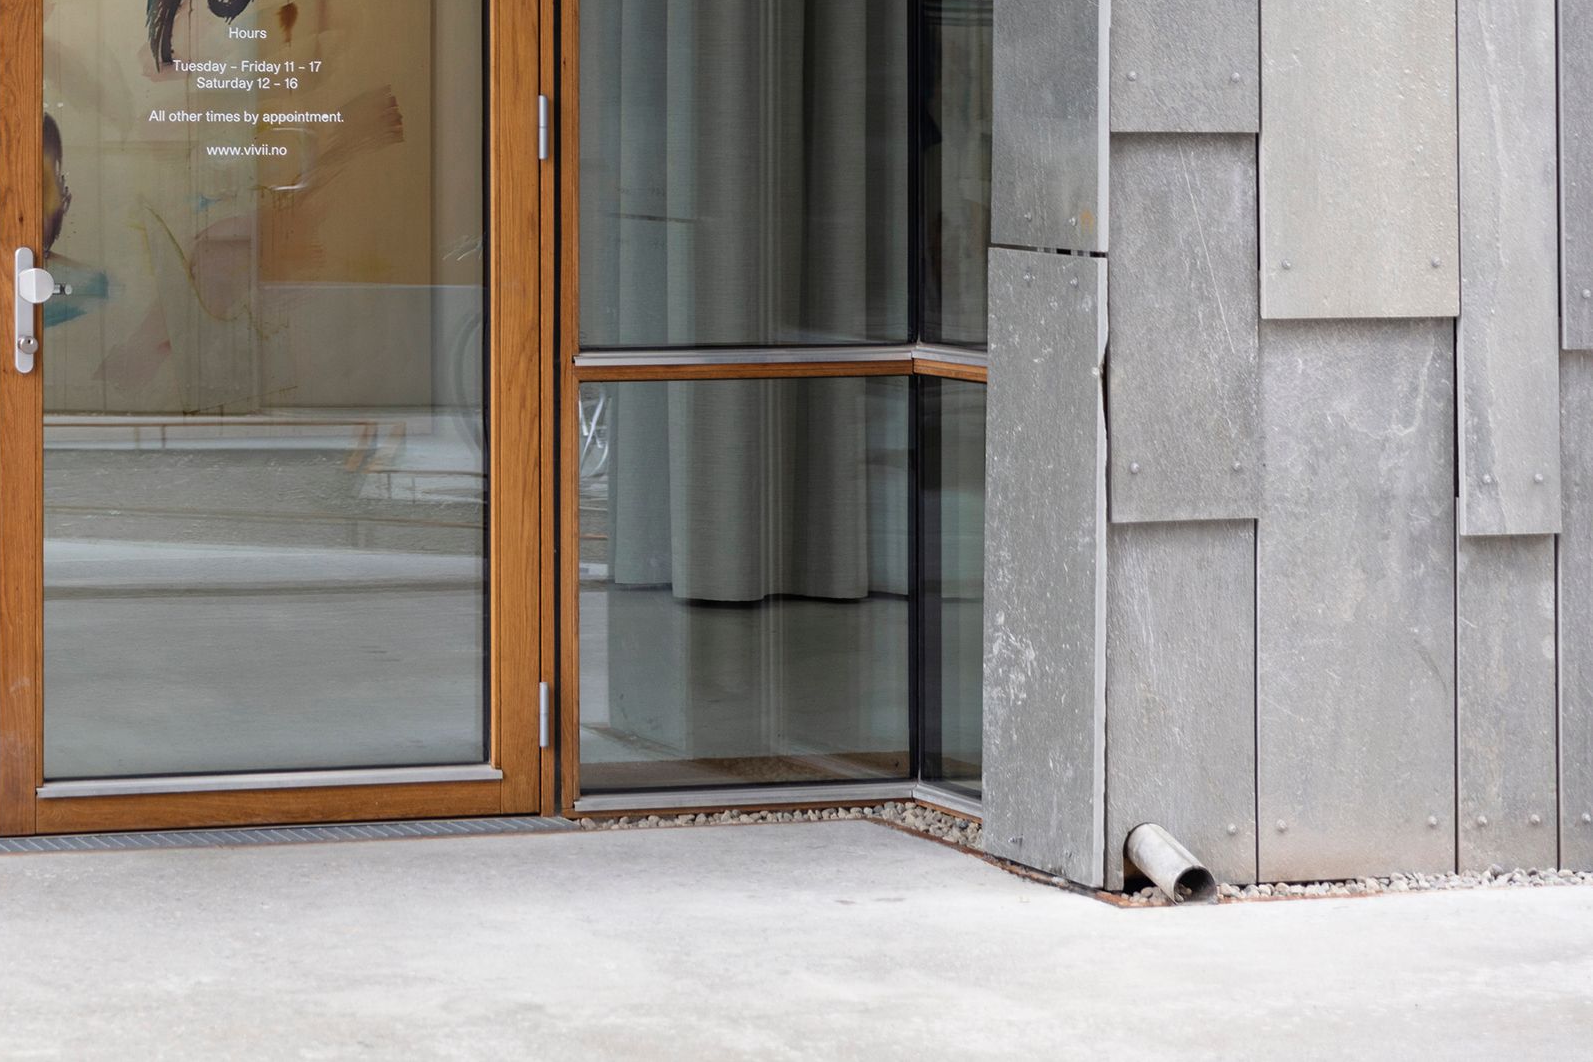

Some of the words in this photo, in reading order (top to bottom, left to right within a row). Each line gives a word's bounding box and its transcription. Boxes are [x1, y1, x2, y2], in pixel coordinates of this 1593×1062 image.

[228, 26, 267, 39] Hours
[172, 59, 228, 75] Tuesday
[240, 60, 281, 75] Friday
[284, 61, 294, 72] 11
[309, 61, 322, 72] 17
[196, 76, 254, 92] Saturday
[256, 77, 271, 89] 12
[284, 77, 298, 90] 16
[149, 109, 166, 123] All
[168, 109, 203, 123] other
[205, 110, 241, 123] times
[243, 110, 259, 125] by
[262, 110, 344, 125] appointment.
[206, 143, 288, 156] www.vivii.no
